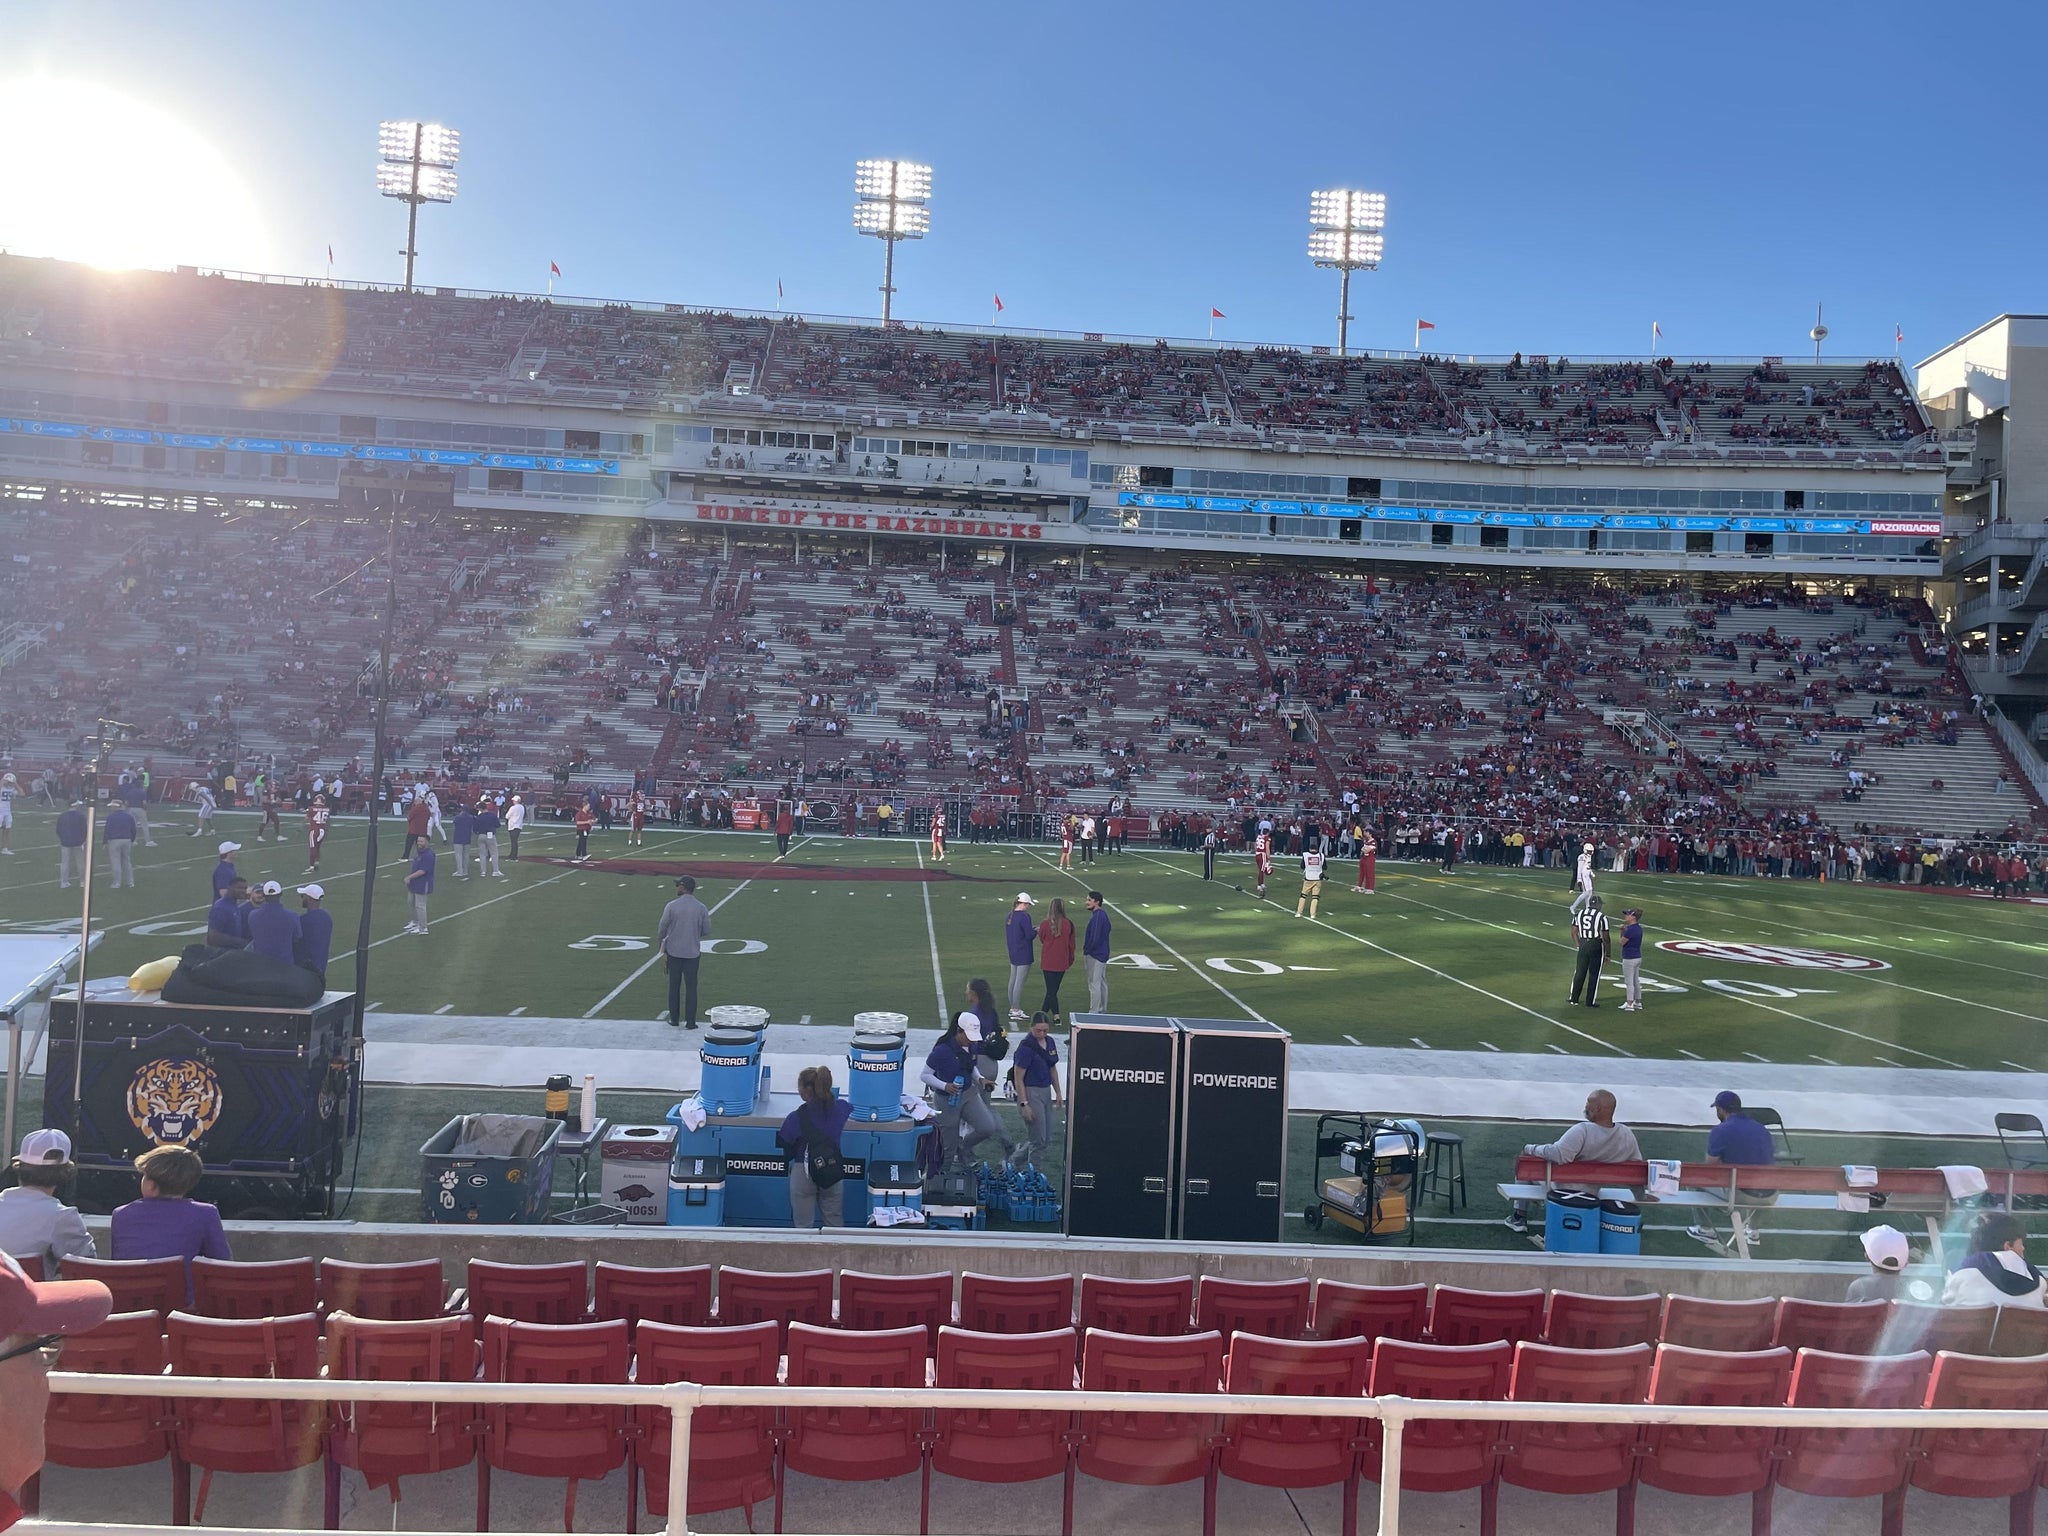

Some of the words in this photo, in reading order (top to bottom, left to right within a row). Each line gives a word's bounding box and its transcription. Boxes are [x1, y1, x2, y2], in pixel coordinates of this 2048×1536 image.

[1312, 347, 1330, 355] W506
[697, 505, 770, 523] HOME
[778, 510, 808, 525] OF
[817, 512, 867, 528] THE
[877, 515, 1041, 539] RAZORBACKS
[1871, 523, 1940, 533] RAZORBACKS
[1582, 915, 1593, 930] S
[704, 1054, 748, 1066] POWERADE
[853, 1061, 898, 1072] POWERADE
[1080, 1067, 1165, 1084] POWERADE
[1192, 1073, 1278, 1089] POWERADE
[726, 1159, 785, 1171] POWERADE
[1600, 1221, 1634, 1233] OWERADE
